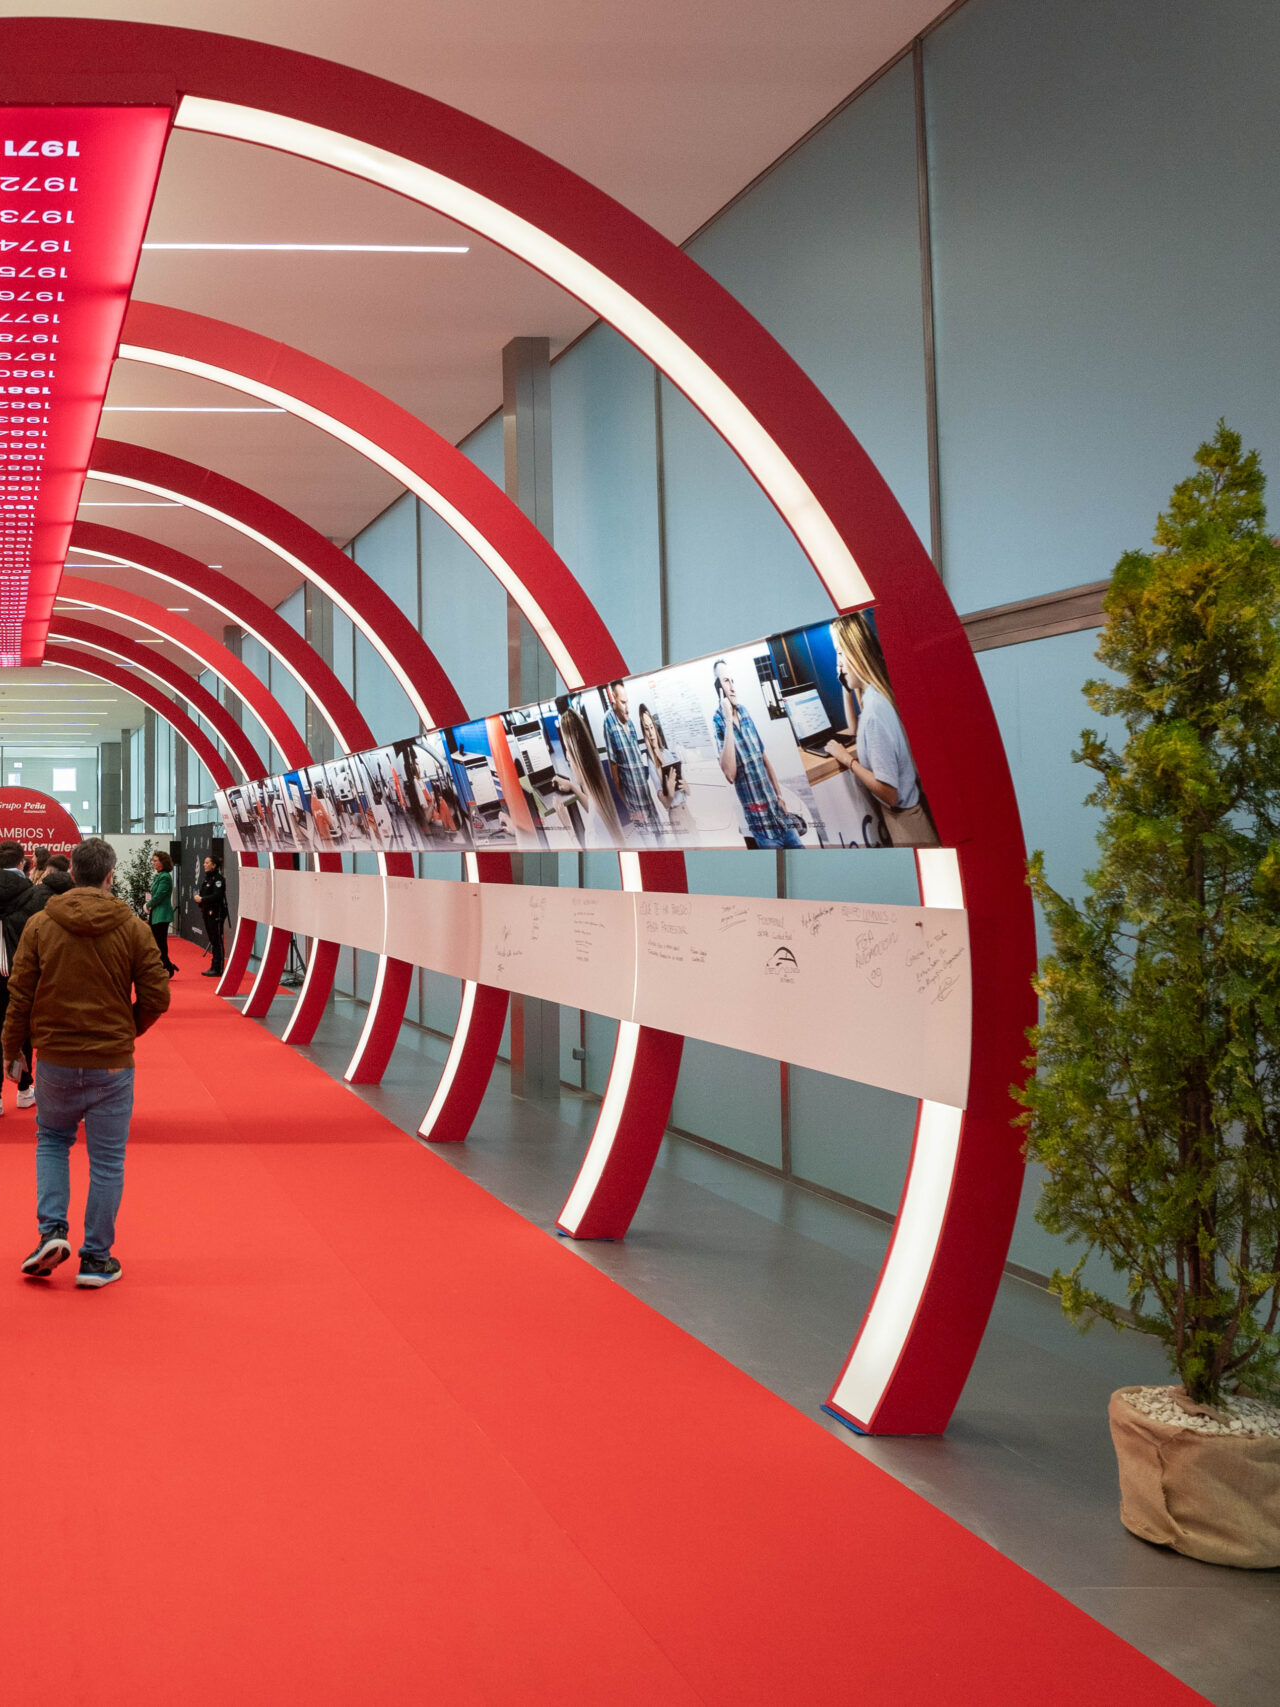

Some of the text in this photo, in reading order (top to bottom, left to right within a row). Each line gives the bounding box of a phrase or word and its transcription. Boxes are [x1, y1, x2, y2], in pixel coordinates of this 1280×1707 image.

[4, 140, 80, 157] 1971
[0, 177, 78, 192] 1972
[0, 210, 75, 223] 1973
[23, 801, 46, 810] Peña
[46, 828, 55, 839] Y
